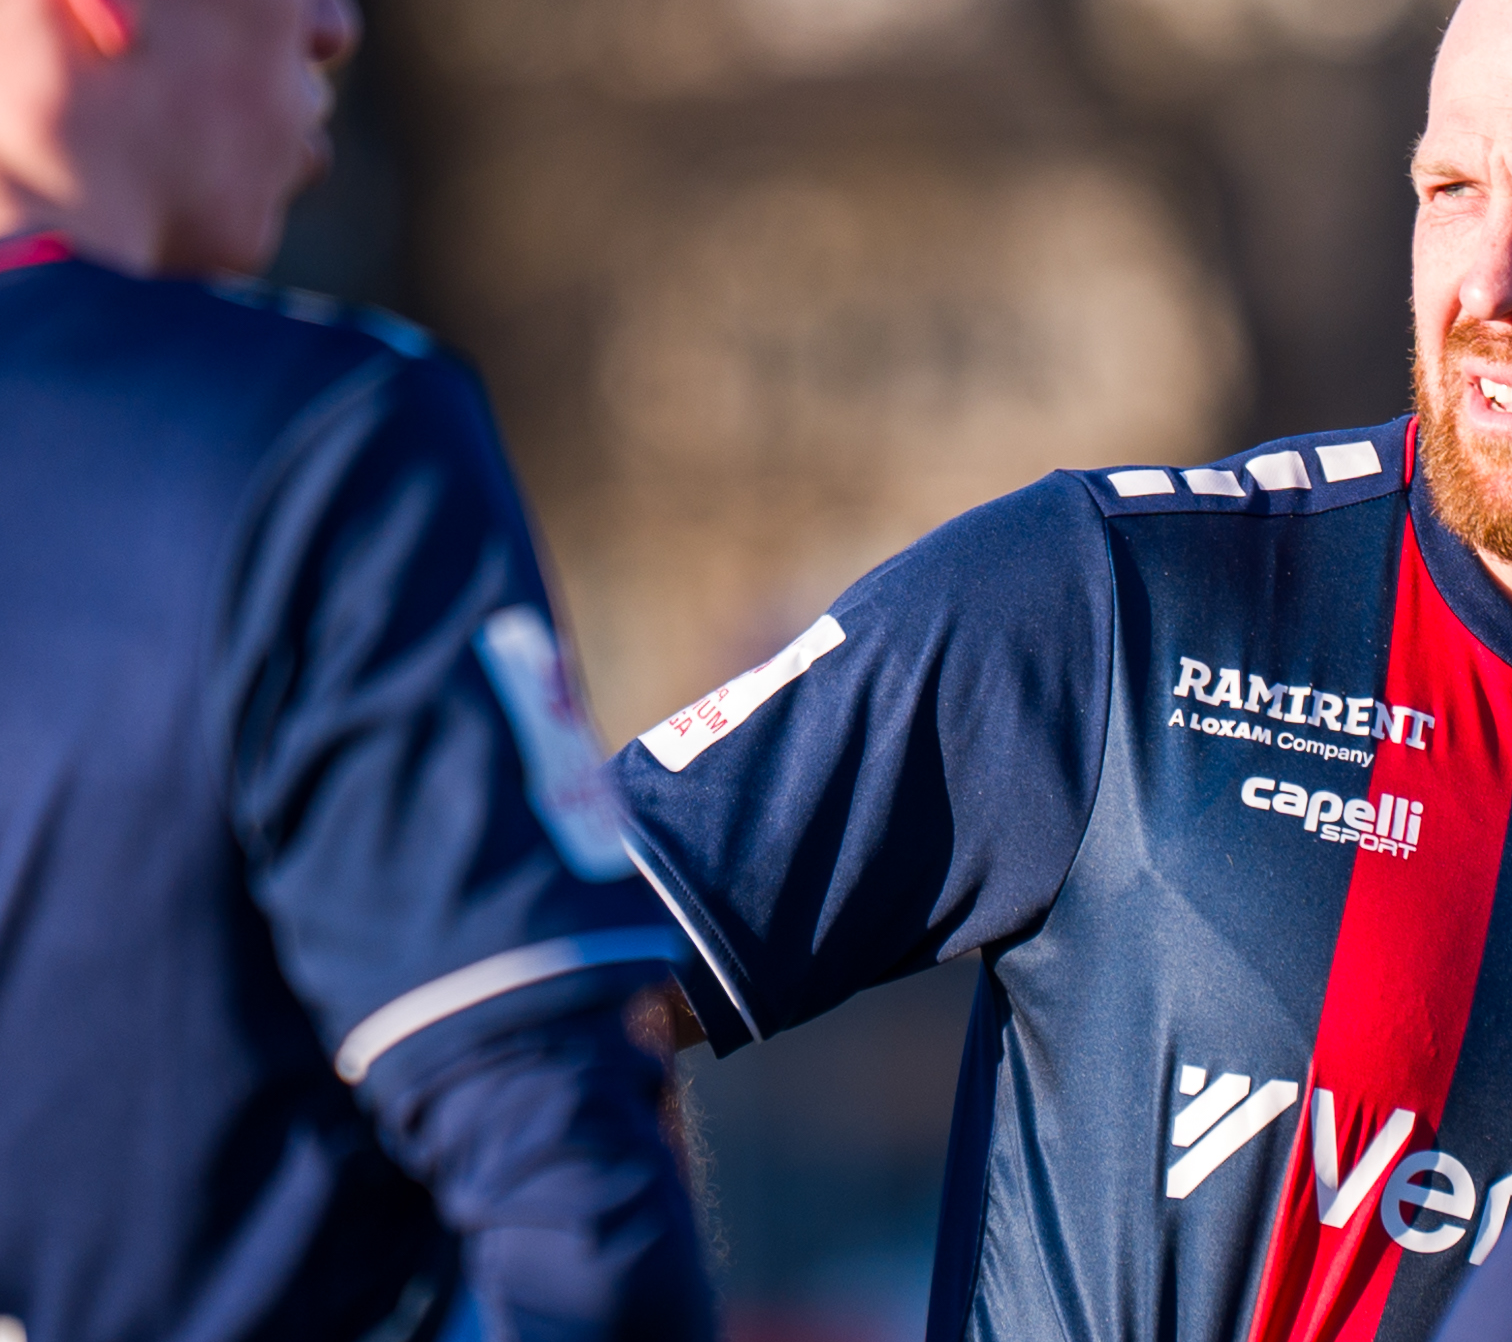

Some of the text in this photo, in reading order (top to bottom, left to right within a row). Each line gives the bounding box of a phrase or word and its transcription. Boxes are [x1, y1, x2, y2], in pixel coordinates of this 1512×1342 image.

[1173, 656, 1436, 750] RAMIRENT
[1168, 708, 1375, 768] A LOXAM Company
[1241, 776, 1425, 846] capelli
[1319, 823, 1418, 860] SPORT
